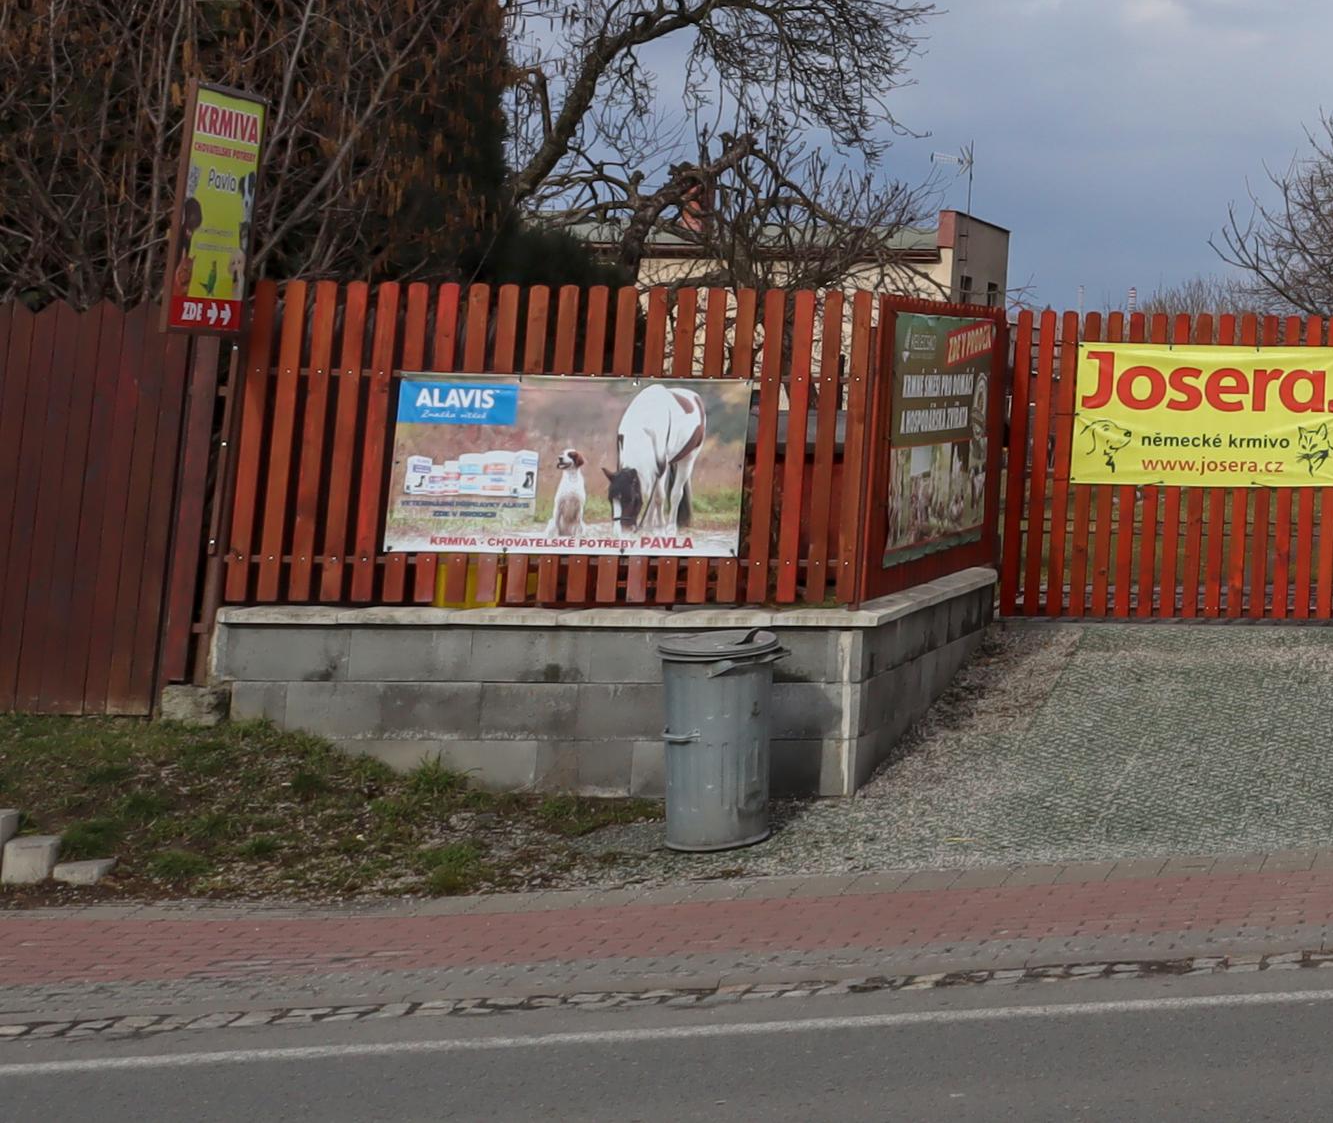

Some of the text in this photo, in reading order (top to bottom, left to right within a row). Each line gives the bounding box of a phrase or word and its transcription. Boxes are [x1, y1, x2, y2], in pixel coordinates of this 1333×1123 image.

[196, 103, 259, 145] KRMIVA
[208, 168, 237, 192] Pavla
[181, 301, 204, 321] ZDE
[416, 387, 495, 409] ALAVIS
[1141, 432, 1291, 449] německé krmivo
[1141, 456, 1285, 476] www.josera.cz
[429, 535, 478, 547] KRMIVA
[487, 536, 576, 548] CHOVATELSKÉ
[579, 536, 636, 549] POTŘEBY
[640, 536, 694, 549] PAVLA
